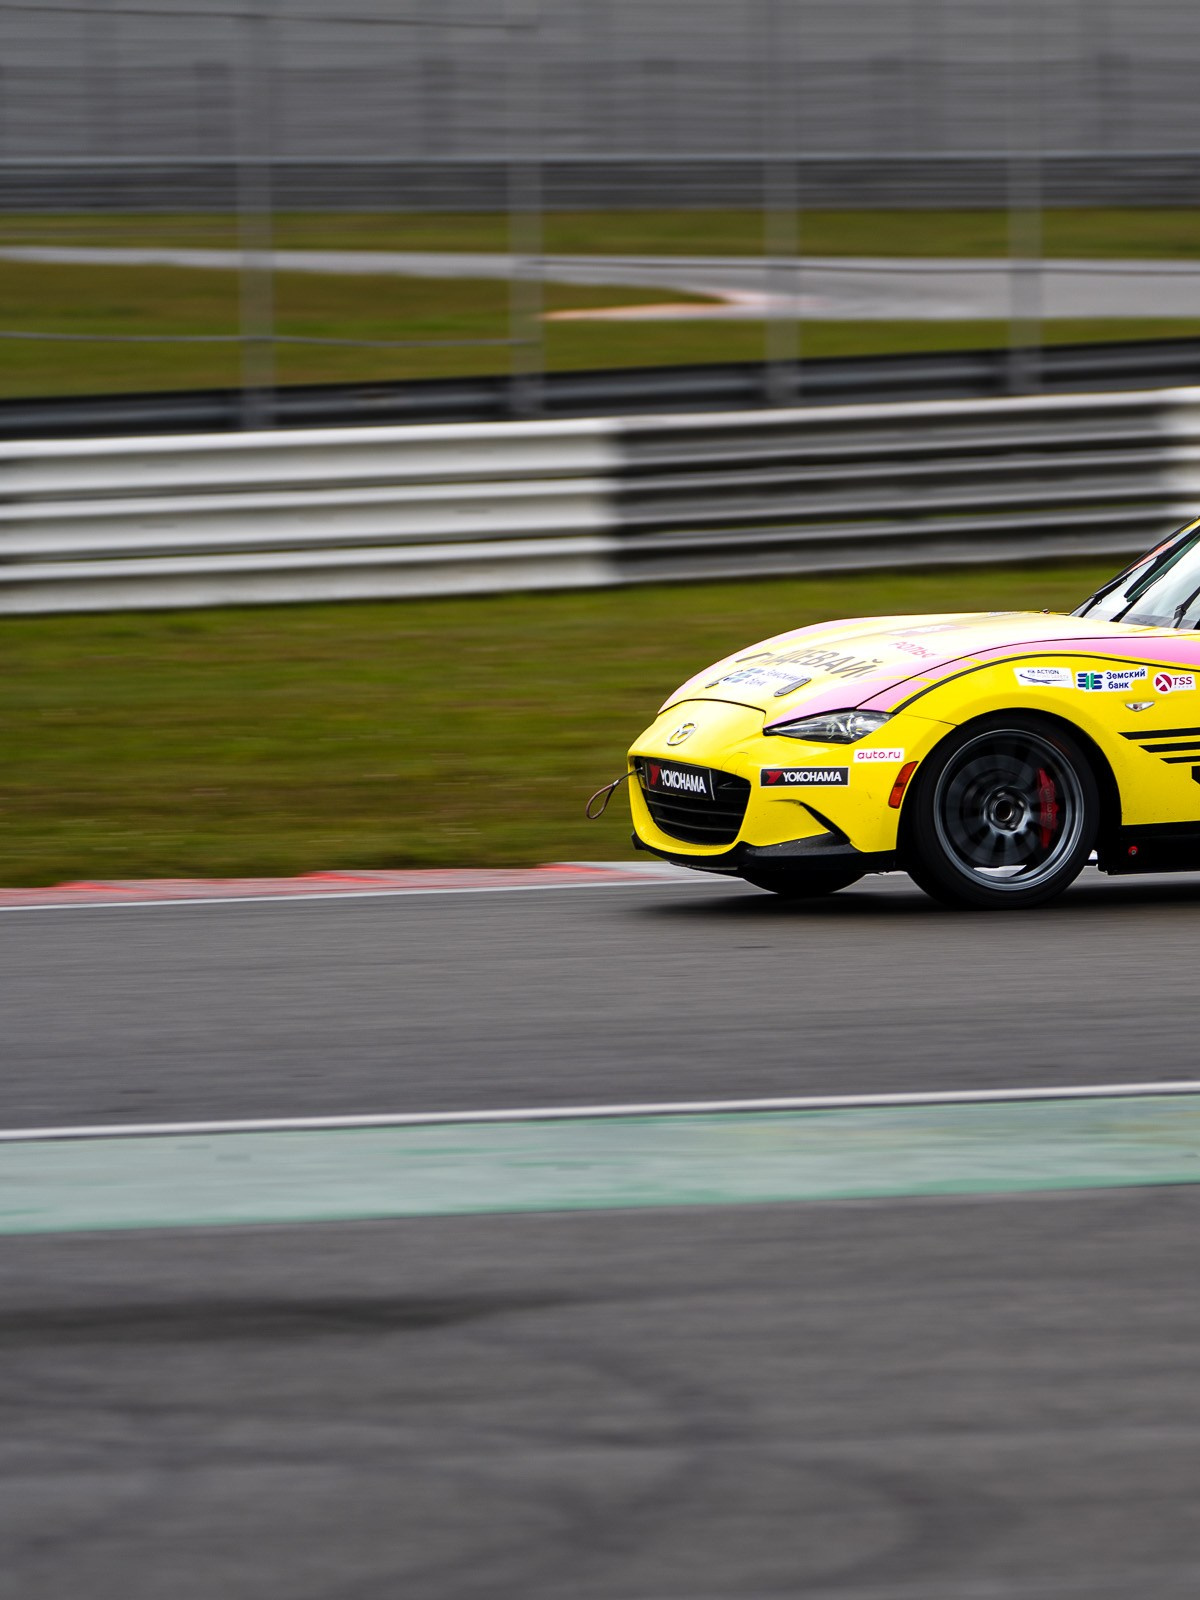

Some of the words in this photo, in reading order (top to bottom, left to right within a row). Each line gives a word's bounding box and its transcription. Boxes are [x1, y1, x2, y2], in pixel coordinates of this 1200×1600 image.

[1106, 668, 1146, 680] Земский
[1108, 681, 1129, 690] банк
[1172, 676, 1193, 686] TSS
[857, 750, 901, 760] auto.ru
[660, 769, 707, 794] YOKOHAMA
[783, 770, 842, 782] YOKOHAMA
